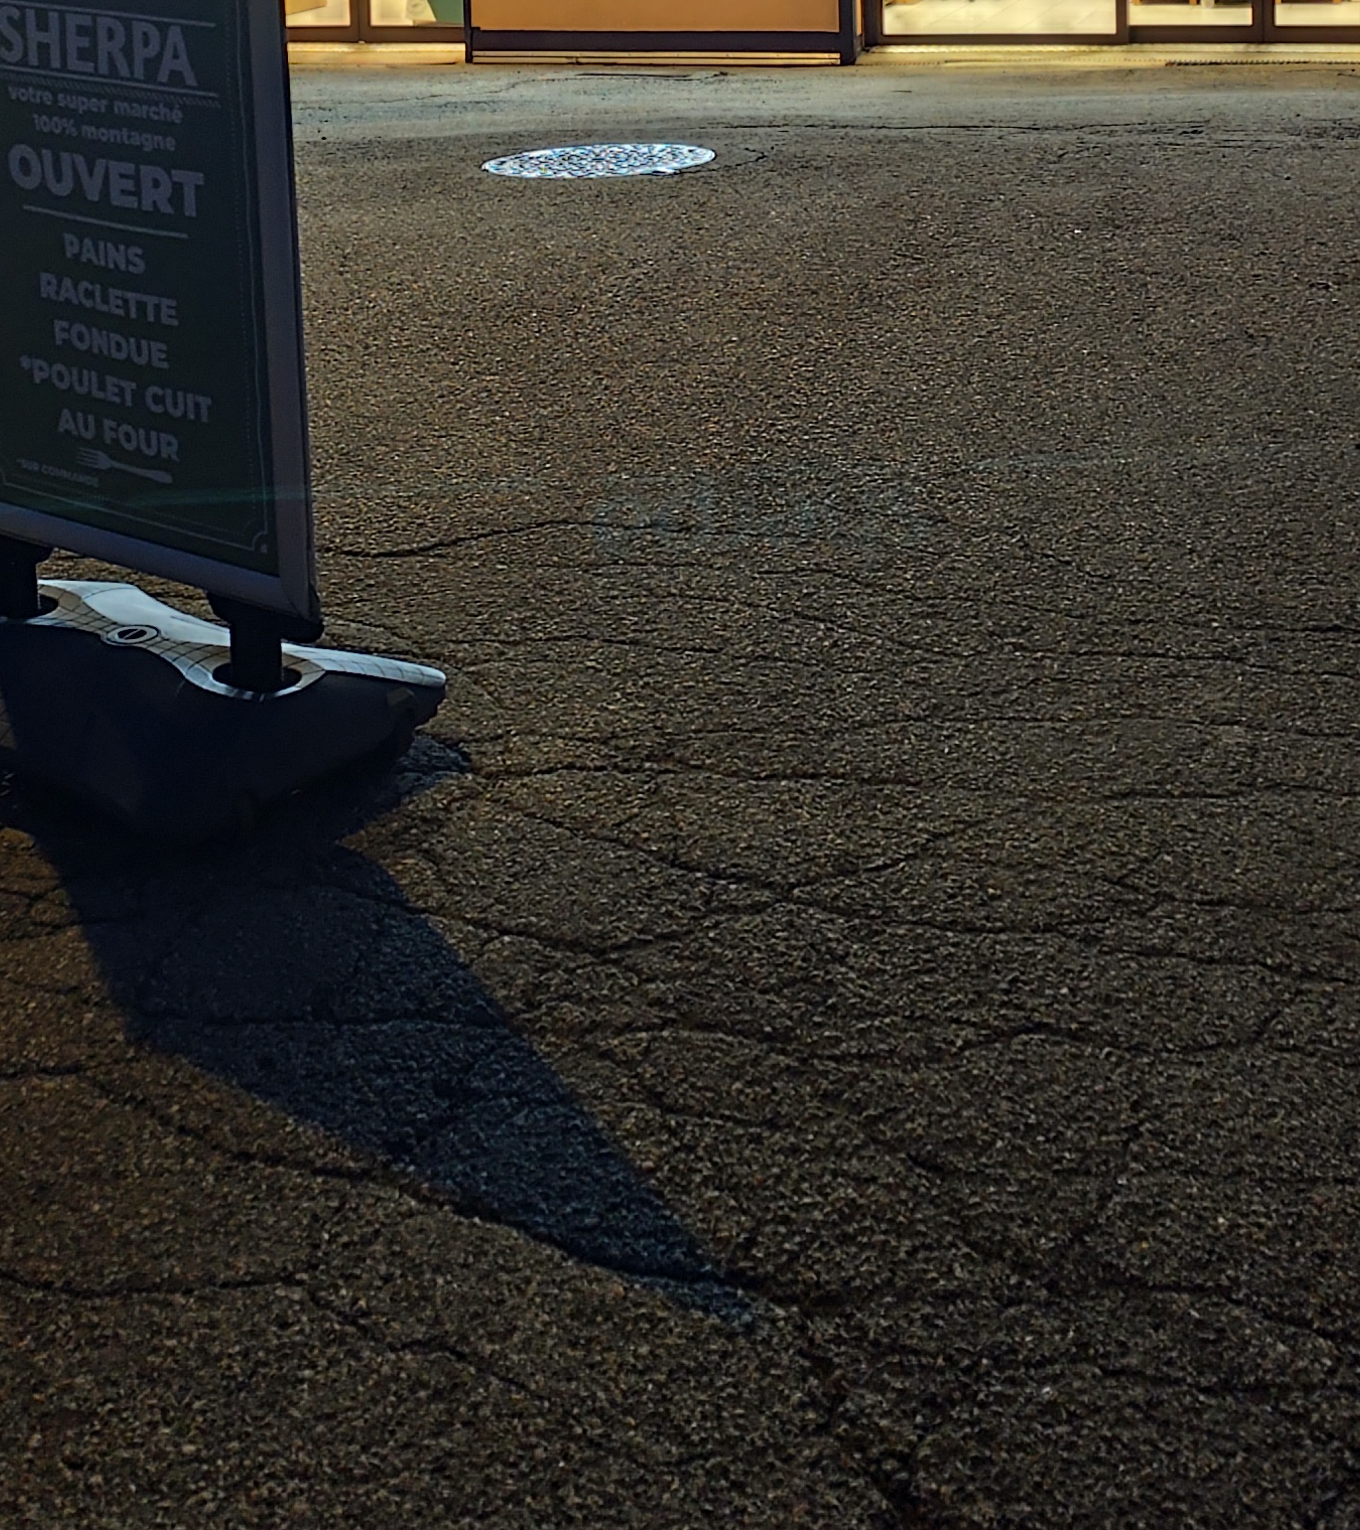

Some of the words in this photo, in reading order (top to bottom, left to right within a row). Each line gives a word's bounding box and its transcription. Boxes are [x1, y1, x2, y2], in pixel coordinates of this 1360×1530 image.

[9, 87, 52, 106] votre
[57, 93, 107, 114] super
[114, 100, 183, 124] marché
[34, 114, 77, 136] 100%
[82, 124, 176, 152] montagne
[9, 143, 204, 218] OUVERT
[63, 232, 146, 275] PAINS
[40, 272, 179, 327] RACLETTE
[54, 318, 169, 370] FONDUE
[145, 383, 212, 424] CUIT
[58, 407, 96, 440] AU
[103, 418, 180, 462] FOUR
